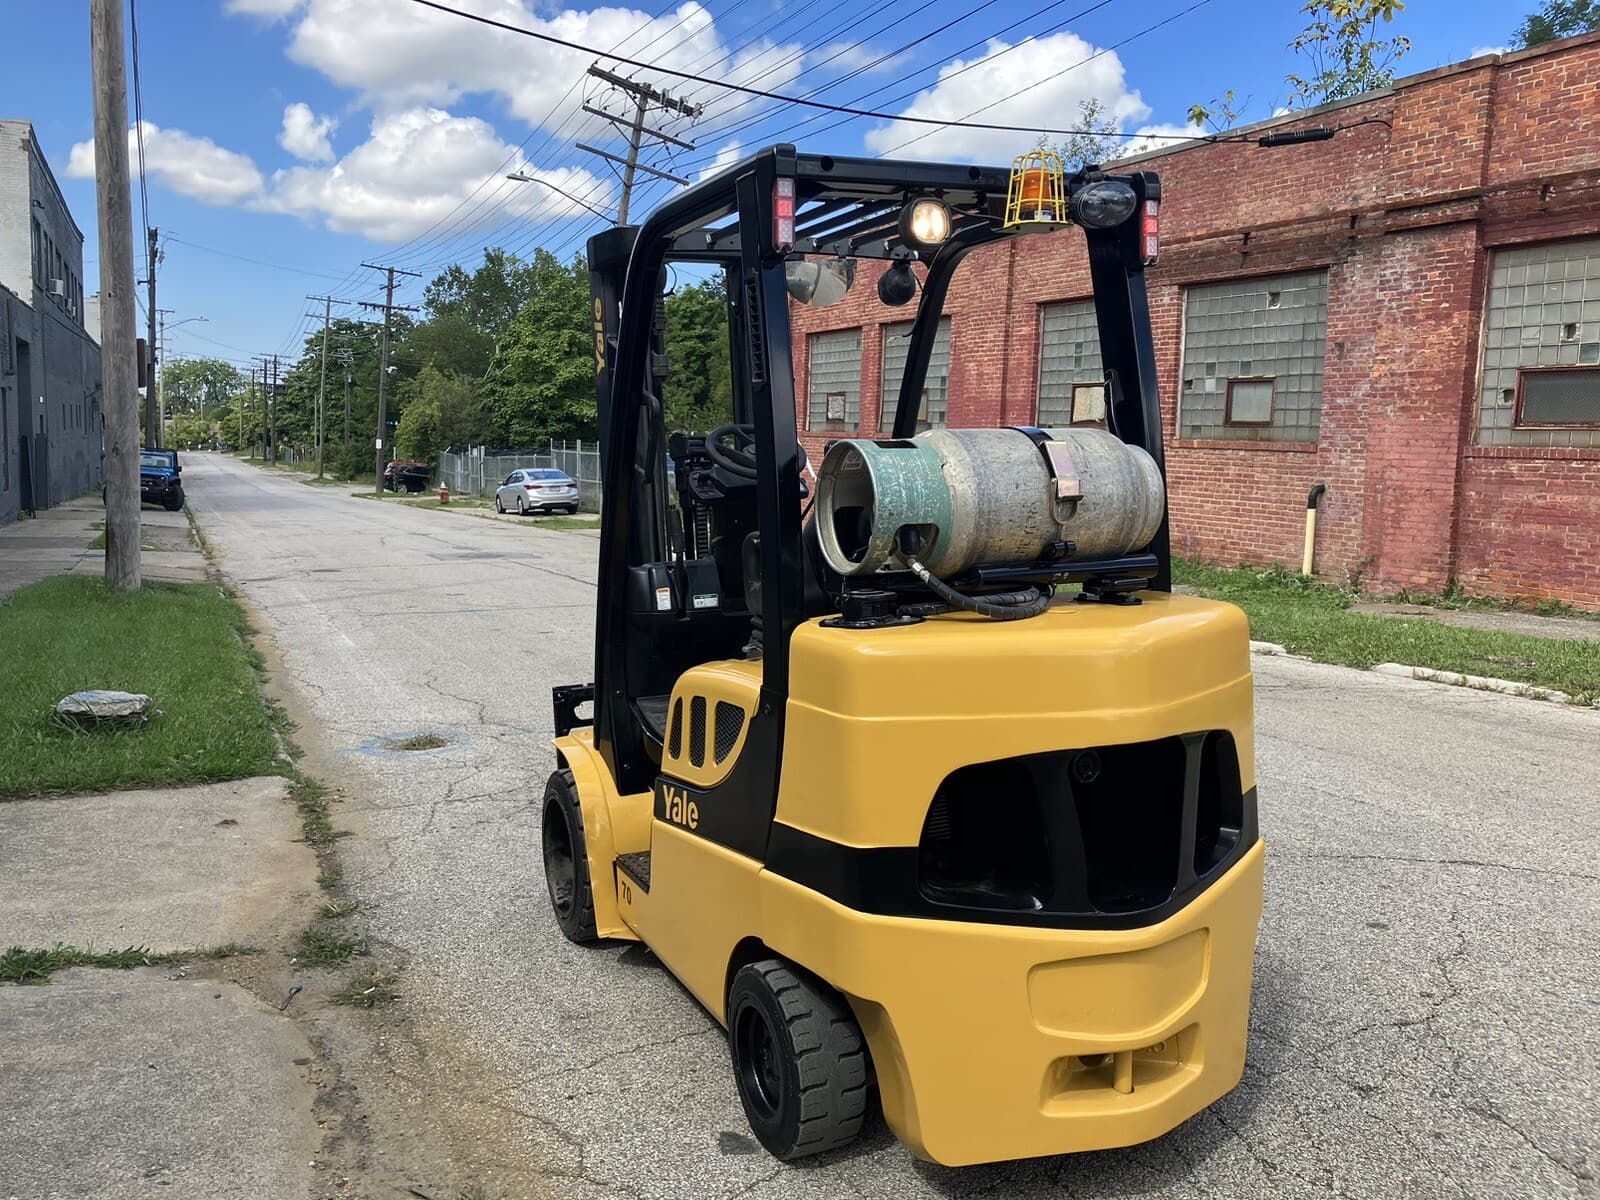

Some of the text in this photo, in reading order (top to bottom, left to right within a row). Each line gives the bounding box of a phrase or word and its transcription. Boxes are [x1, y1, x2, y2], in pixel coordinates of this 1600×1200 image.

[594, 297, 605, 375] Yale
[663, 784, 698, 829] Yale
[621, 880, 632, 906] 70
